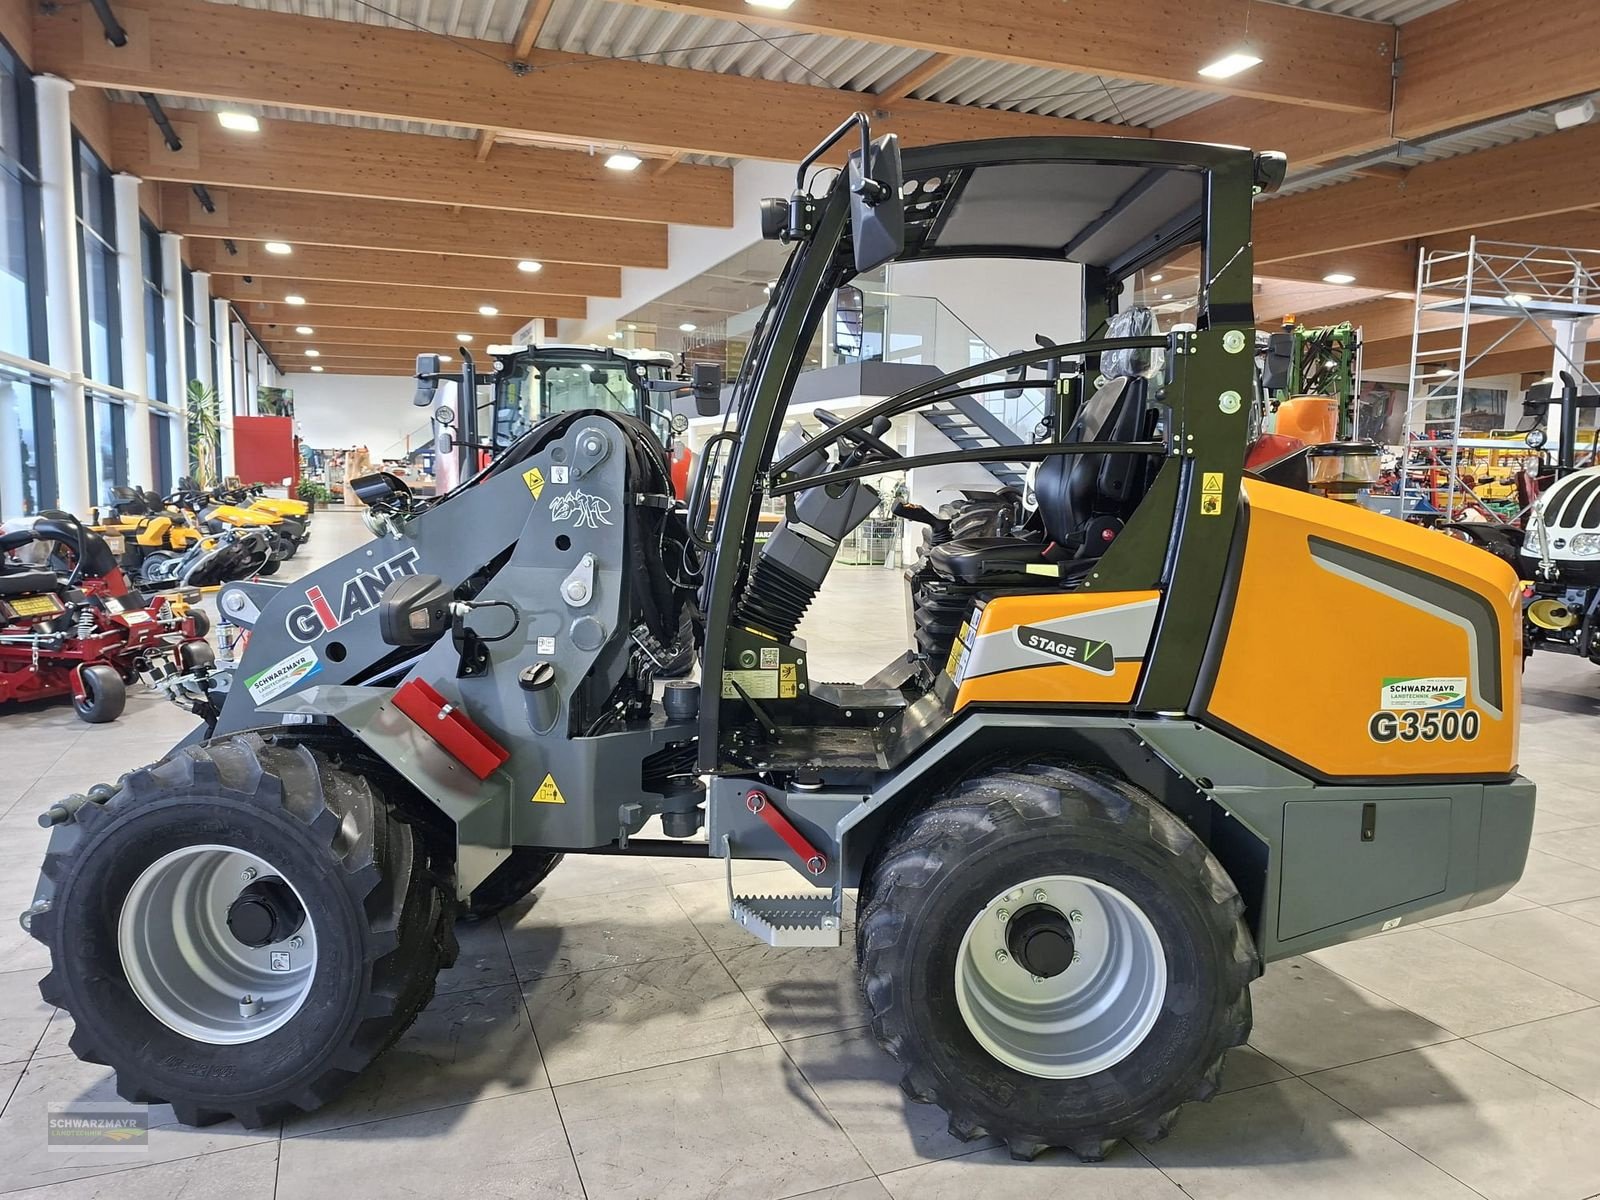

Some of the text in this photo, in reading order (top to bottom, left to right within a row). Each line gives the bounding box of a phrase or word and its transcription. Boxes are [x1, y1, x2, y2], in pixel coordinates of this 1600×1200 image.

[1028, 635, 1077, 658] STAGE
[254, 657, 307, 690] SCHWARZMAYR
[1389, 685, 1455, 693] SCHWARZMAYR
[1368, 710, 1480, 743] G3500
